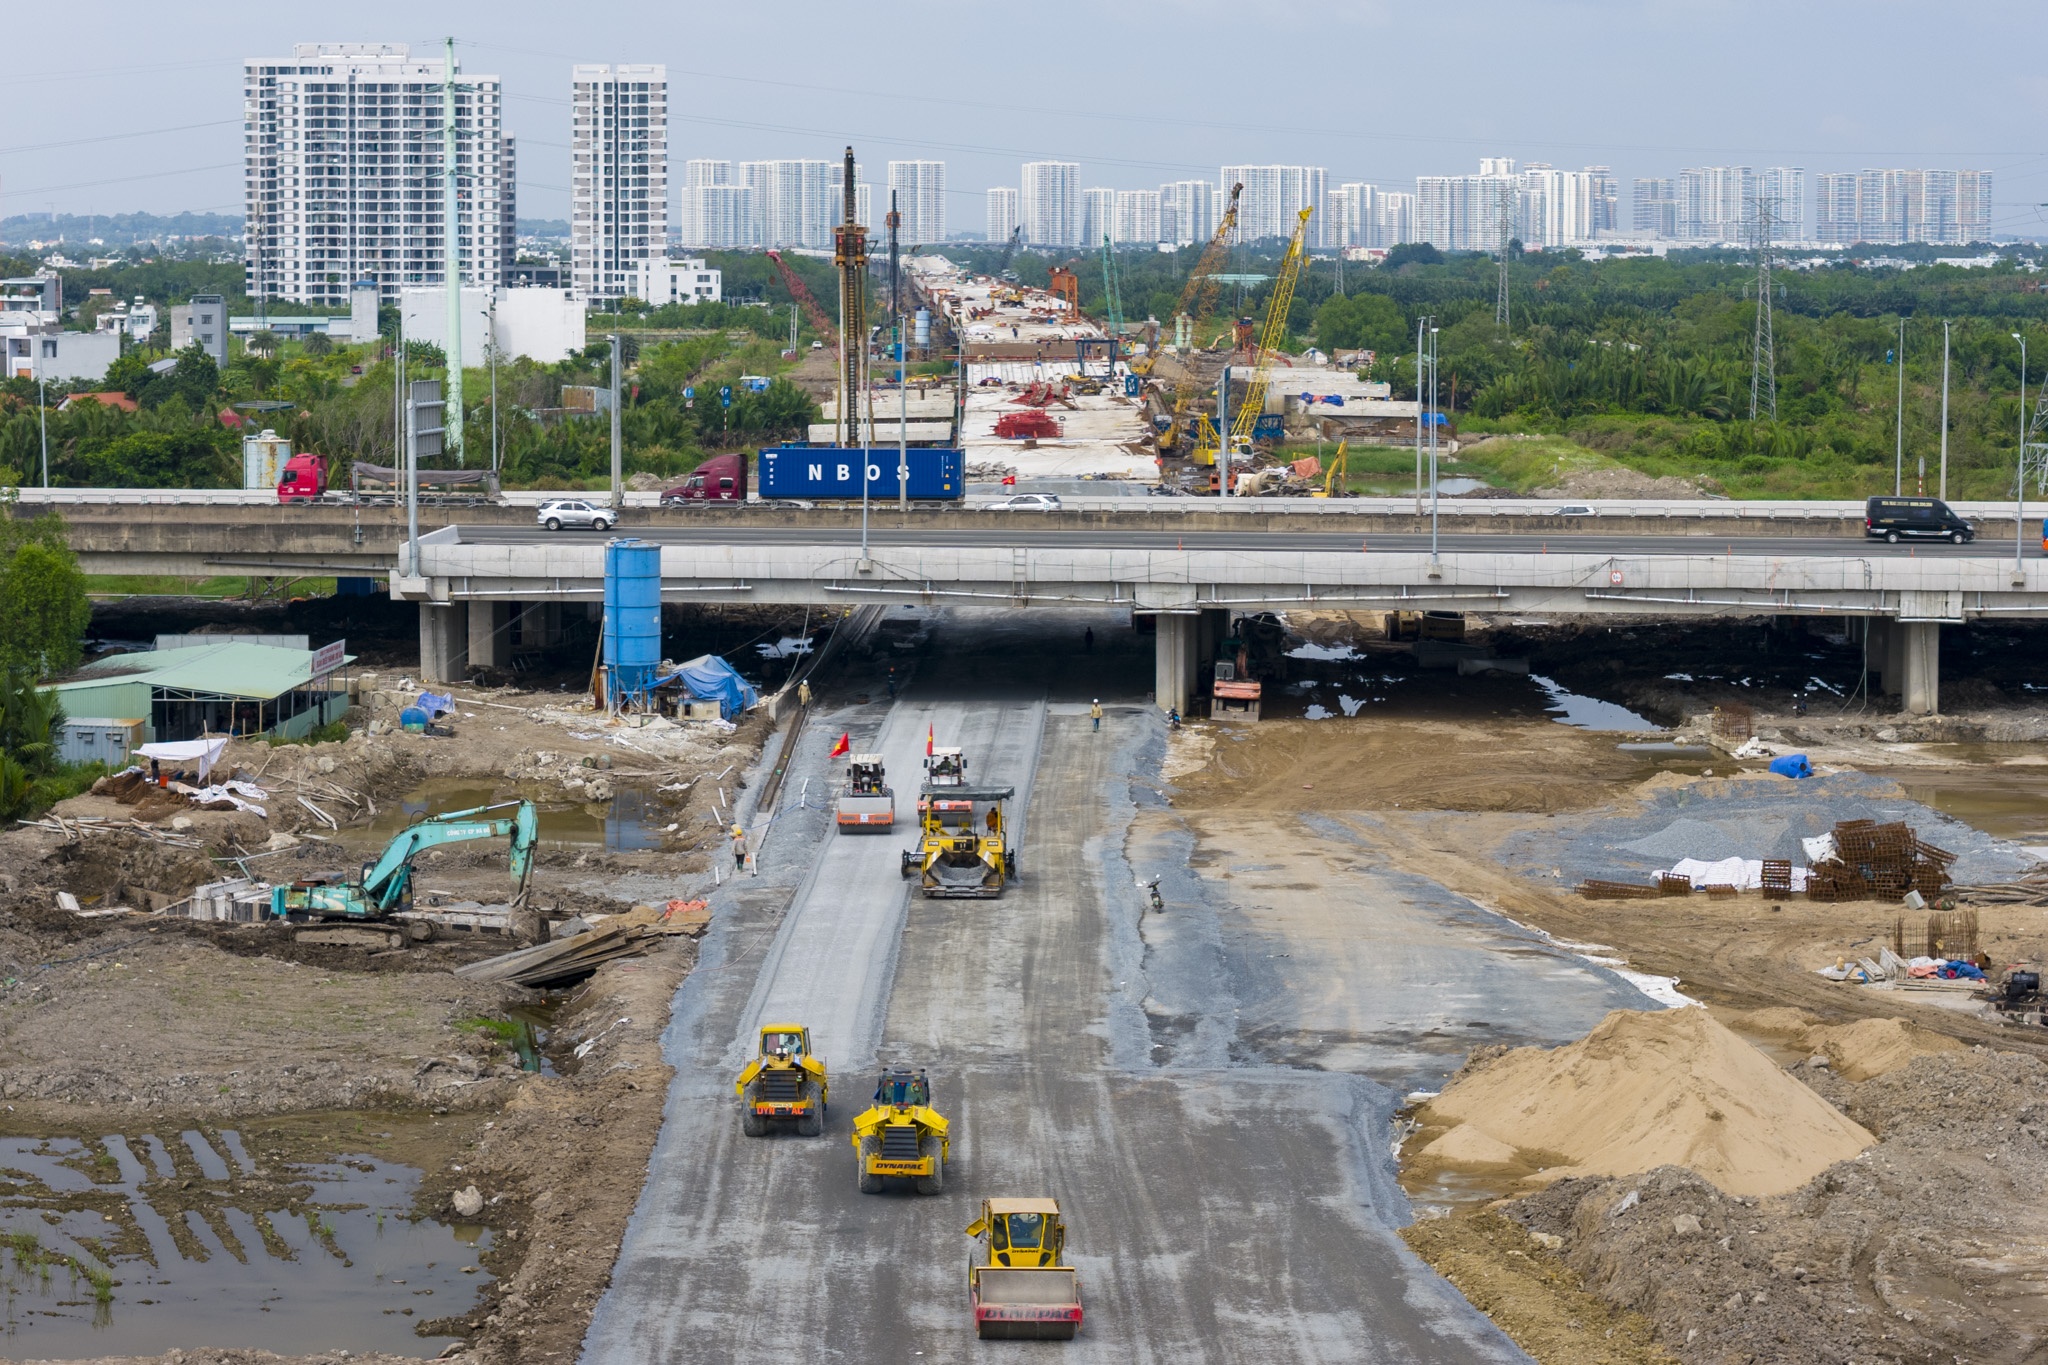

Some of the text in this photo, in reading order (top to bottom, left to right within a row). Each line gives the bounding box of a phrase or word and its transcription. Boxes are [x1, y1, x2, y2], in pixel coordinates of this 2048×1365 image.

[808, 464, 910, 481] NBOS
[756, 1106, 804, 1115] DYNAC
[984, 1308, 1075, 1319] DYNAPAC
